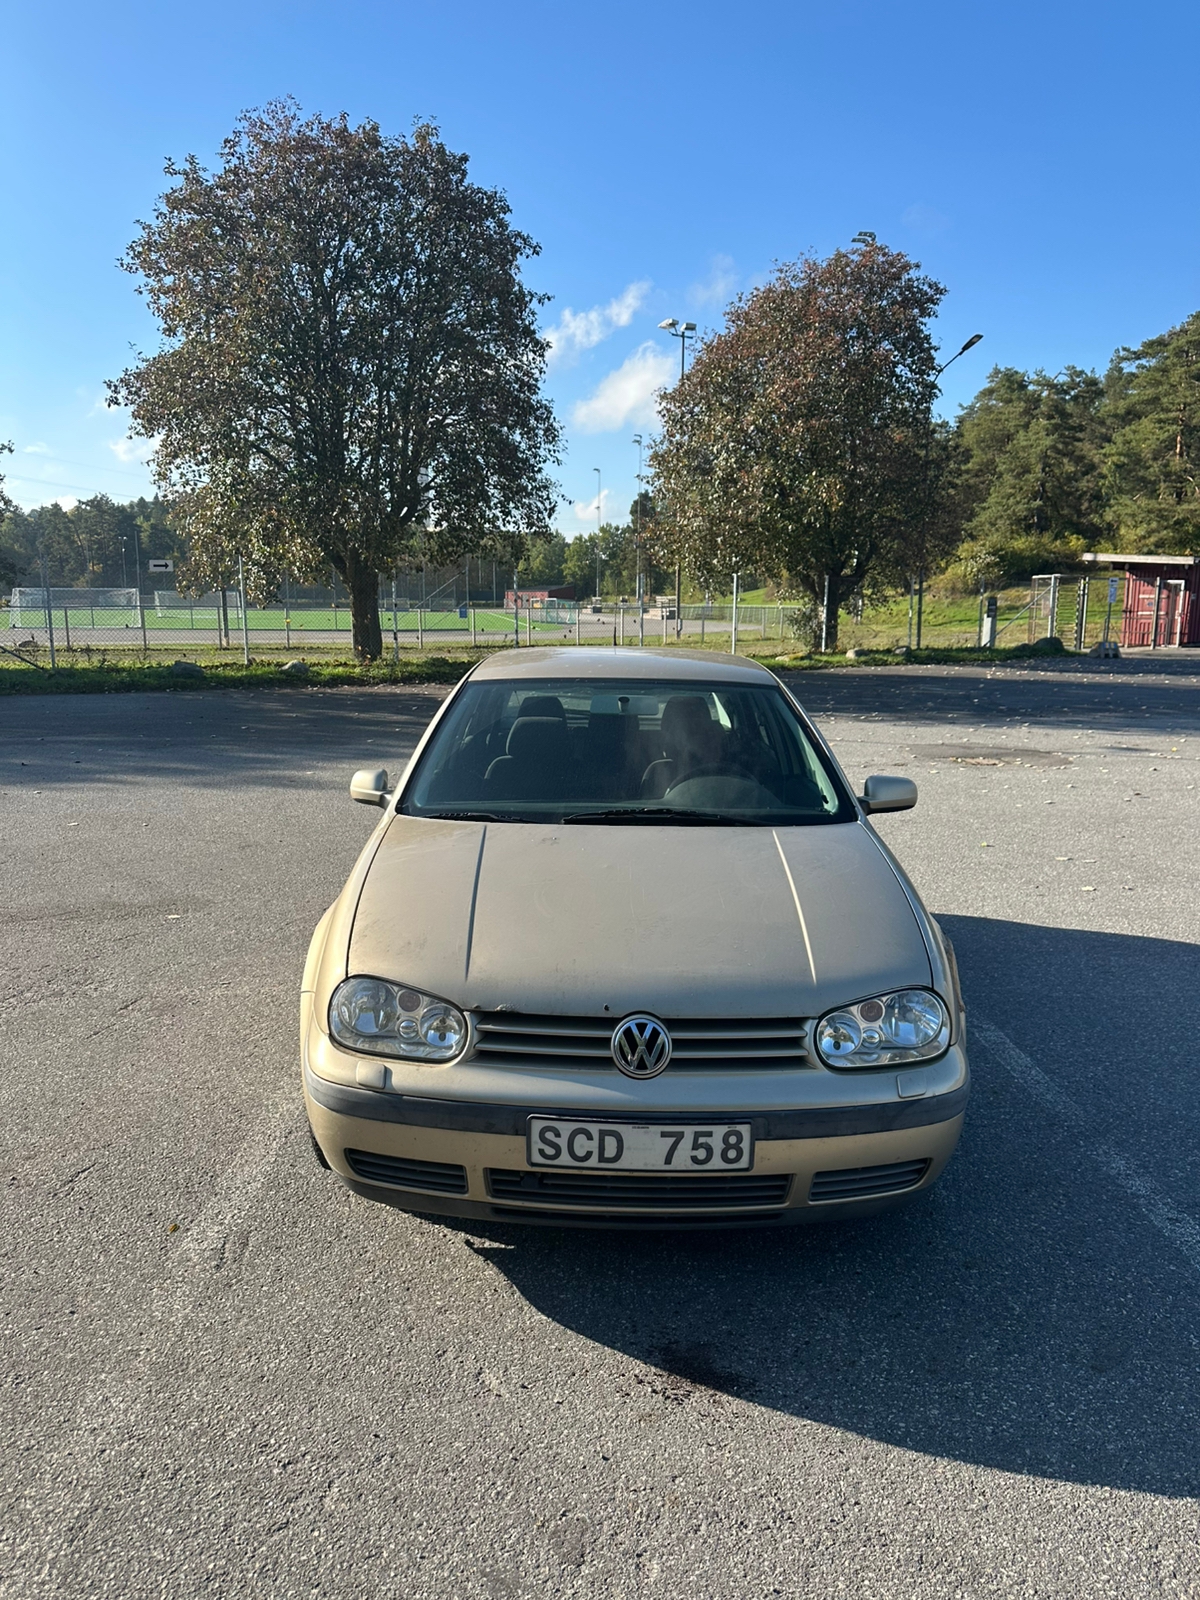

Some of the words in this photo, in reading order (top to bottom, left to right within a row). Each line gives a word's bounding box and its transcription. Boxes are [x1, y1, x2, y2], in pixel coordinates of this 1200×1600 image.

[614, 1017, 670, 1074] VW
[538, 1125, 624, 1163] SCD
[660, 1129, 744, 1165] 758
